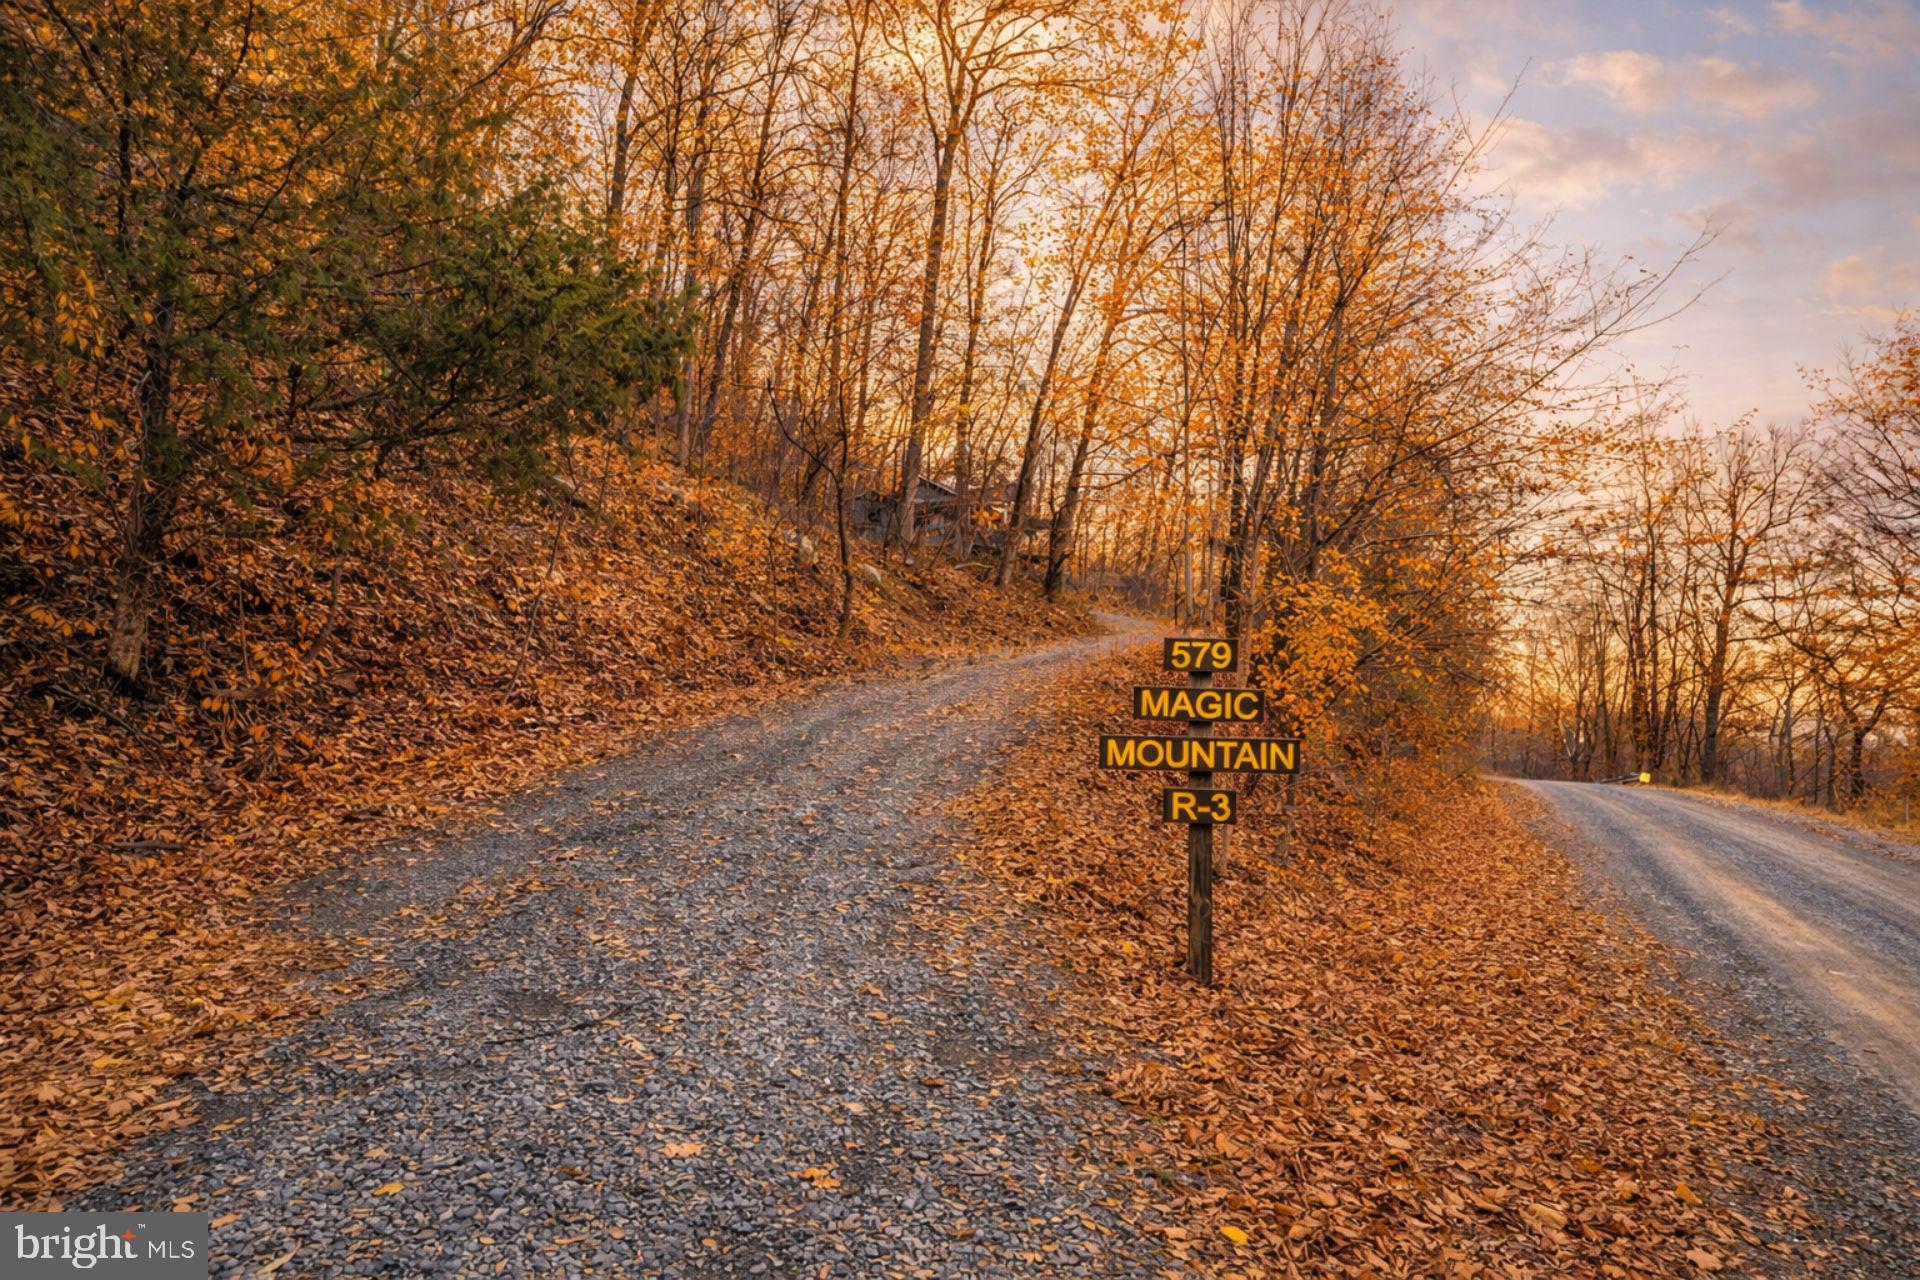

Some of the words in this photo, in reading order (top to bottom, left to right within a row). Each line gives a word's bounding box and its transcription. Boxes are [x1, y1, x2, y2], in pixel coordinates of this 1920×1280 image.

[1171, 641, 1232, 669] 579
[1140, 689, 1259, 720] MAGIC
[1106, 738, 1295, 770] MOUNTAIN
[1171, 791, 1231, 822] R-3
